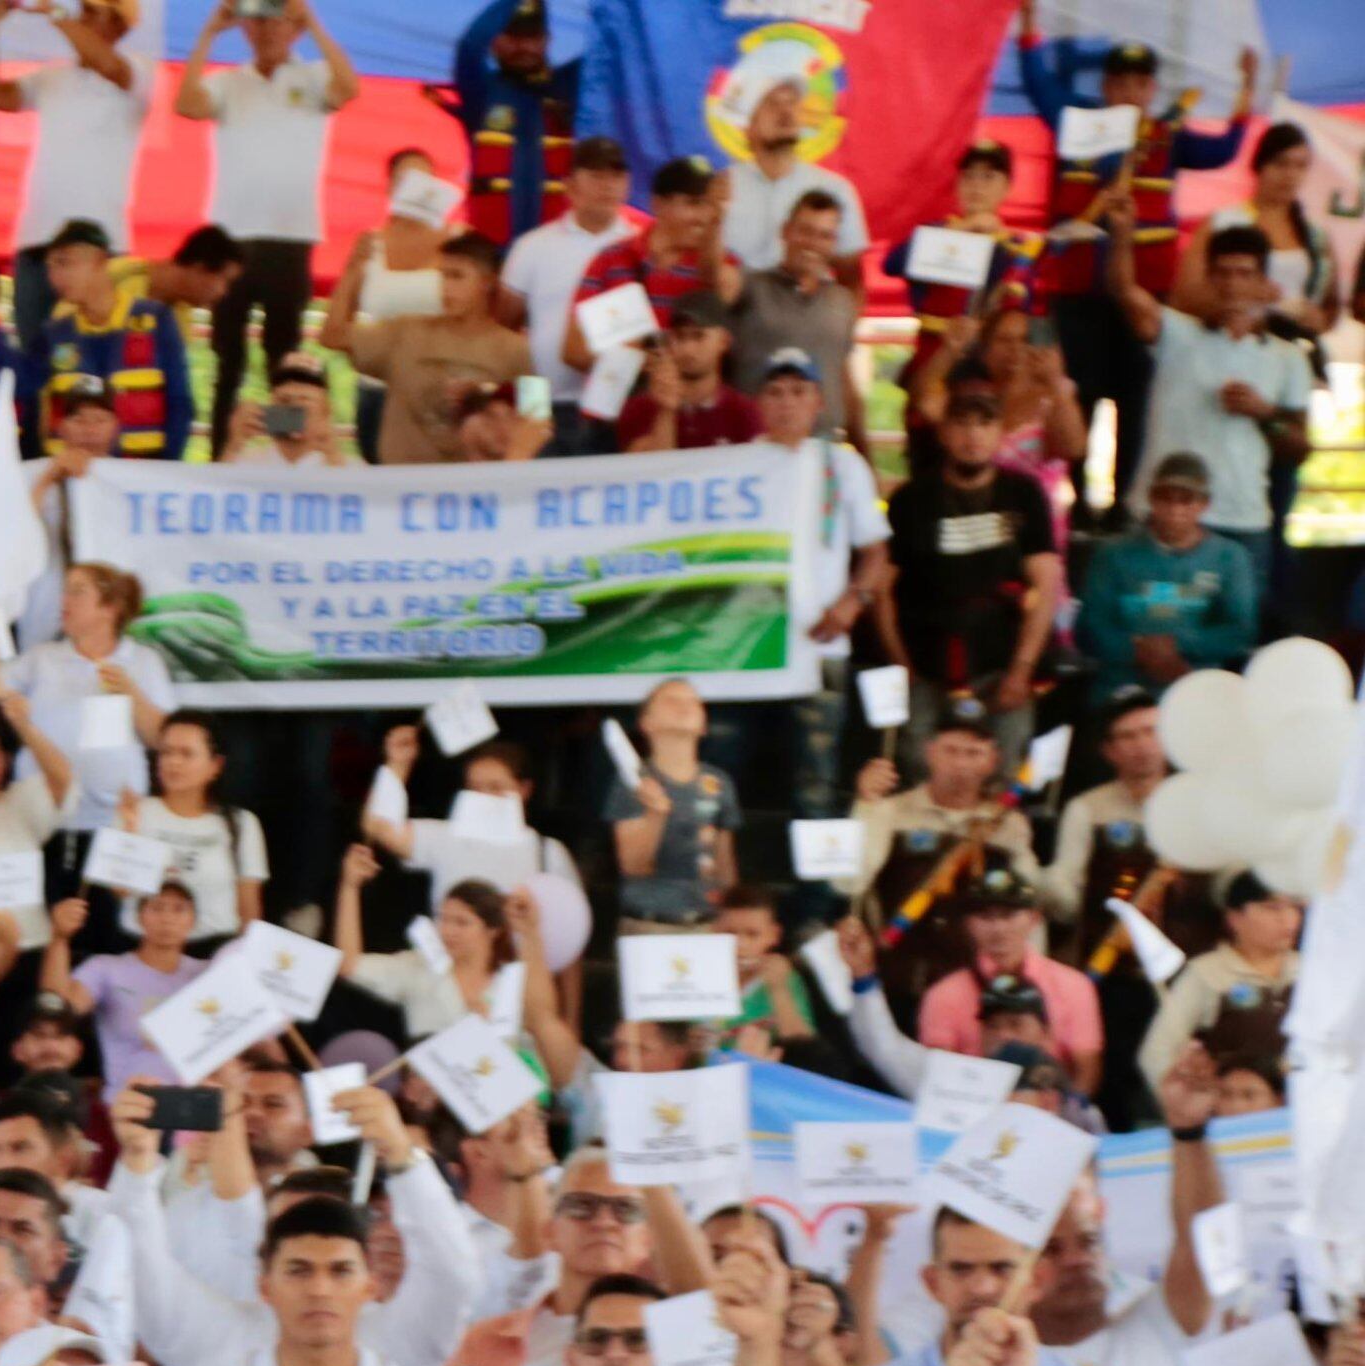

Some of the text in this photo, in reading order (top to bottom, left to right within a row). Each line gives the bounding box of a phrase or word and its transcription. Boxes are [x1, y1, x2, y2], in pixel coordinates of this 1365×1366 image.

[127, 475, 764, 536] TEORAMA CON ACAPOES
[190, 561, 259, 584] POR
[271, 562, 309, 584] EL
[325, 559, 493, 584] DERECHO
[542, 556, 584, 580] LA
[599, 552, 685, 577] VIDA
[351, 598, 387, 618] LA
[402, 596, 466, 619] PAZ
[479, 594, 524, 617] EN
[537, 592, 582, 616] EL
[311, 625, 544, 657] TERRITORIO
